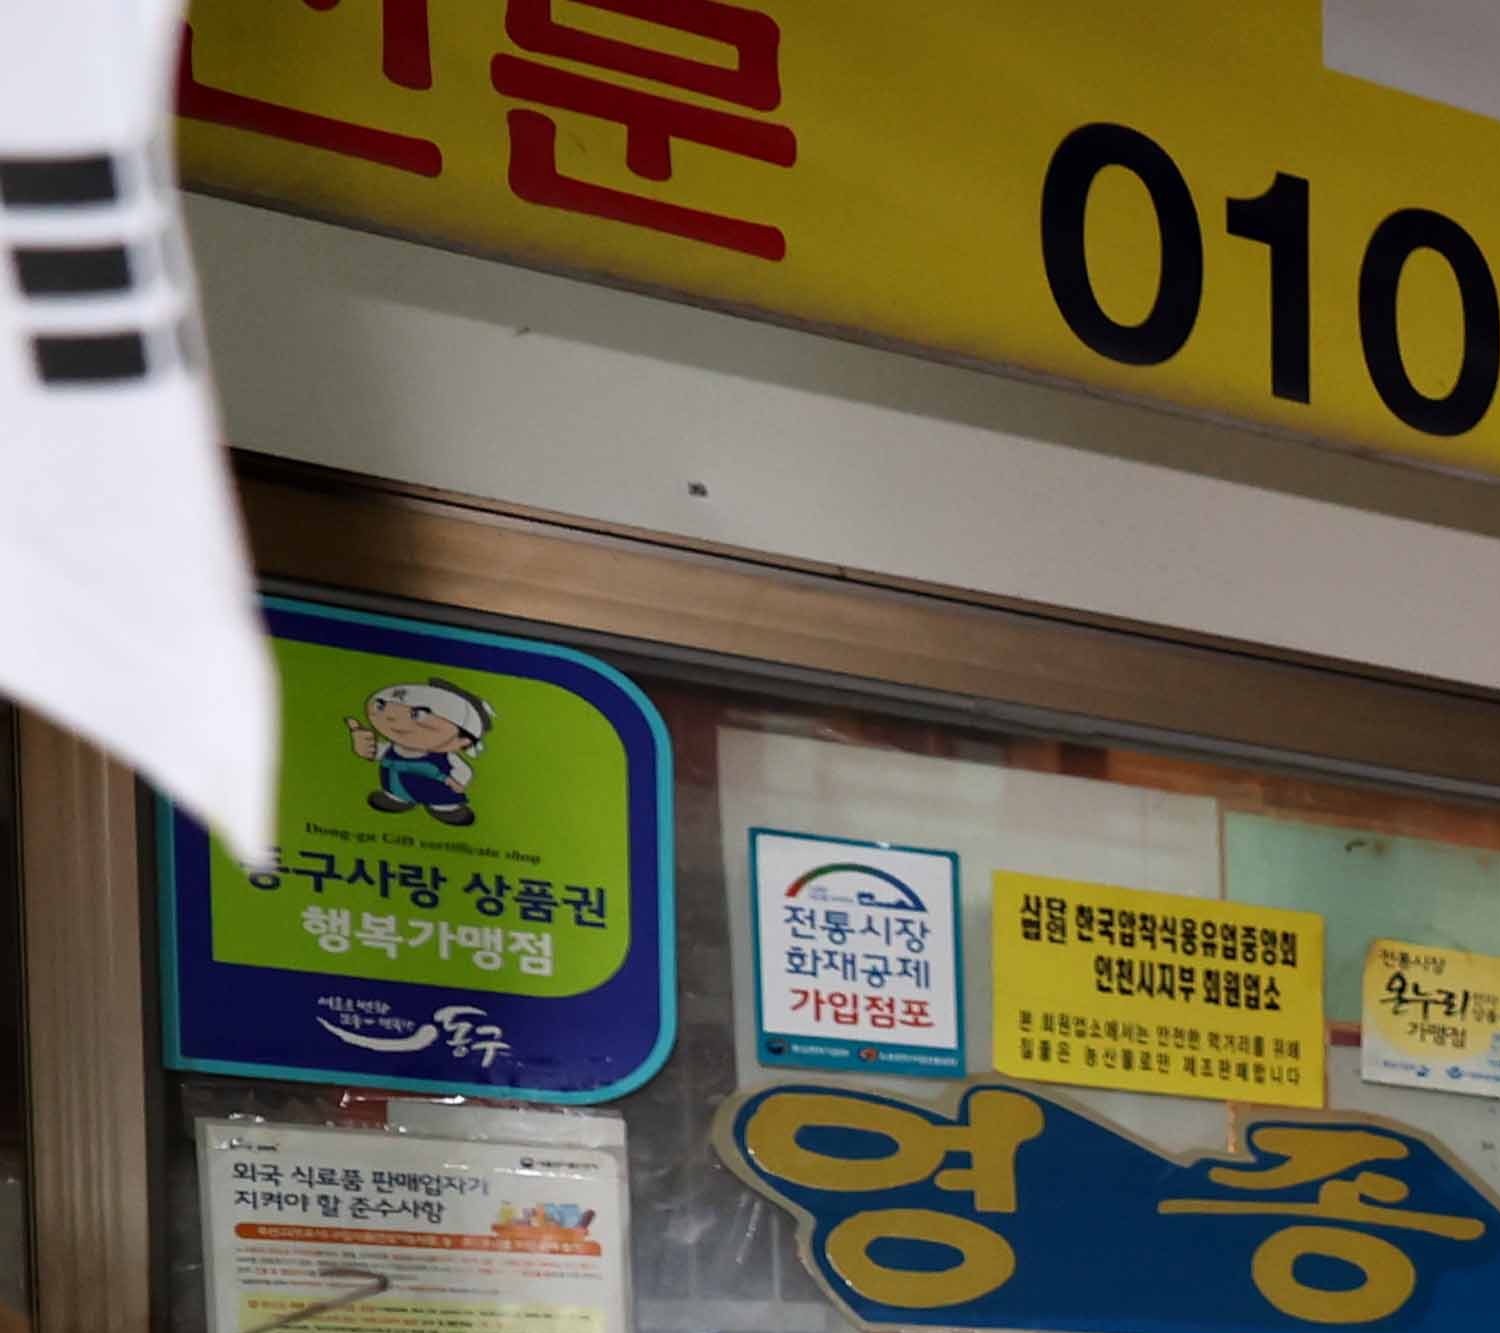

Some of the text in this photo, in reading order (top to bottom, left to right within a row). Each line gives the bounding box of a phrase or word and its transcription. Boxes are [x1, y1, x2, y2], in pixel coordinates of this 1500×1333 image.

[463, 873, 608, 930] 상품권
[301, 904, 554, 977] 행복가맹점
[783, 905, 932, 955] 전통시장
[785, 946, 931, 990] 화재공제
[789, 988, 935, 1029] 가입점포
[1379, 969, 1472, 1021] 온누리
[231, 1159, 284, 1189] 외국
[291, 1164, 364, 1193] 식료품
[234, 1189, 445, 1225] 지켜야 할 준수사항
[741, 1086, 1485, 1324] 영종
